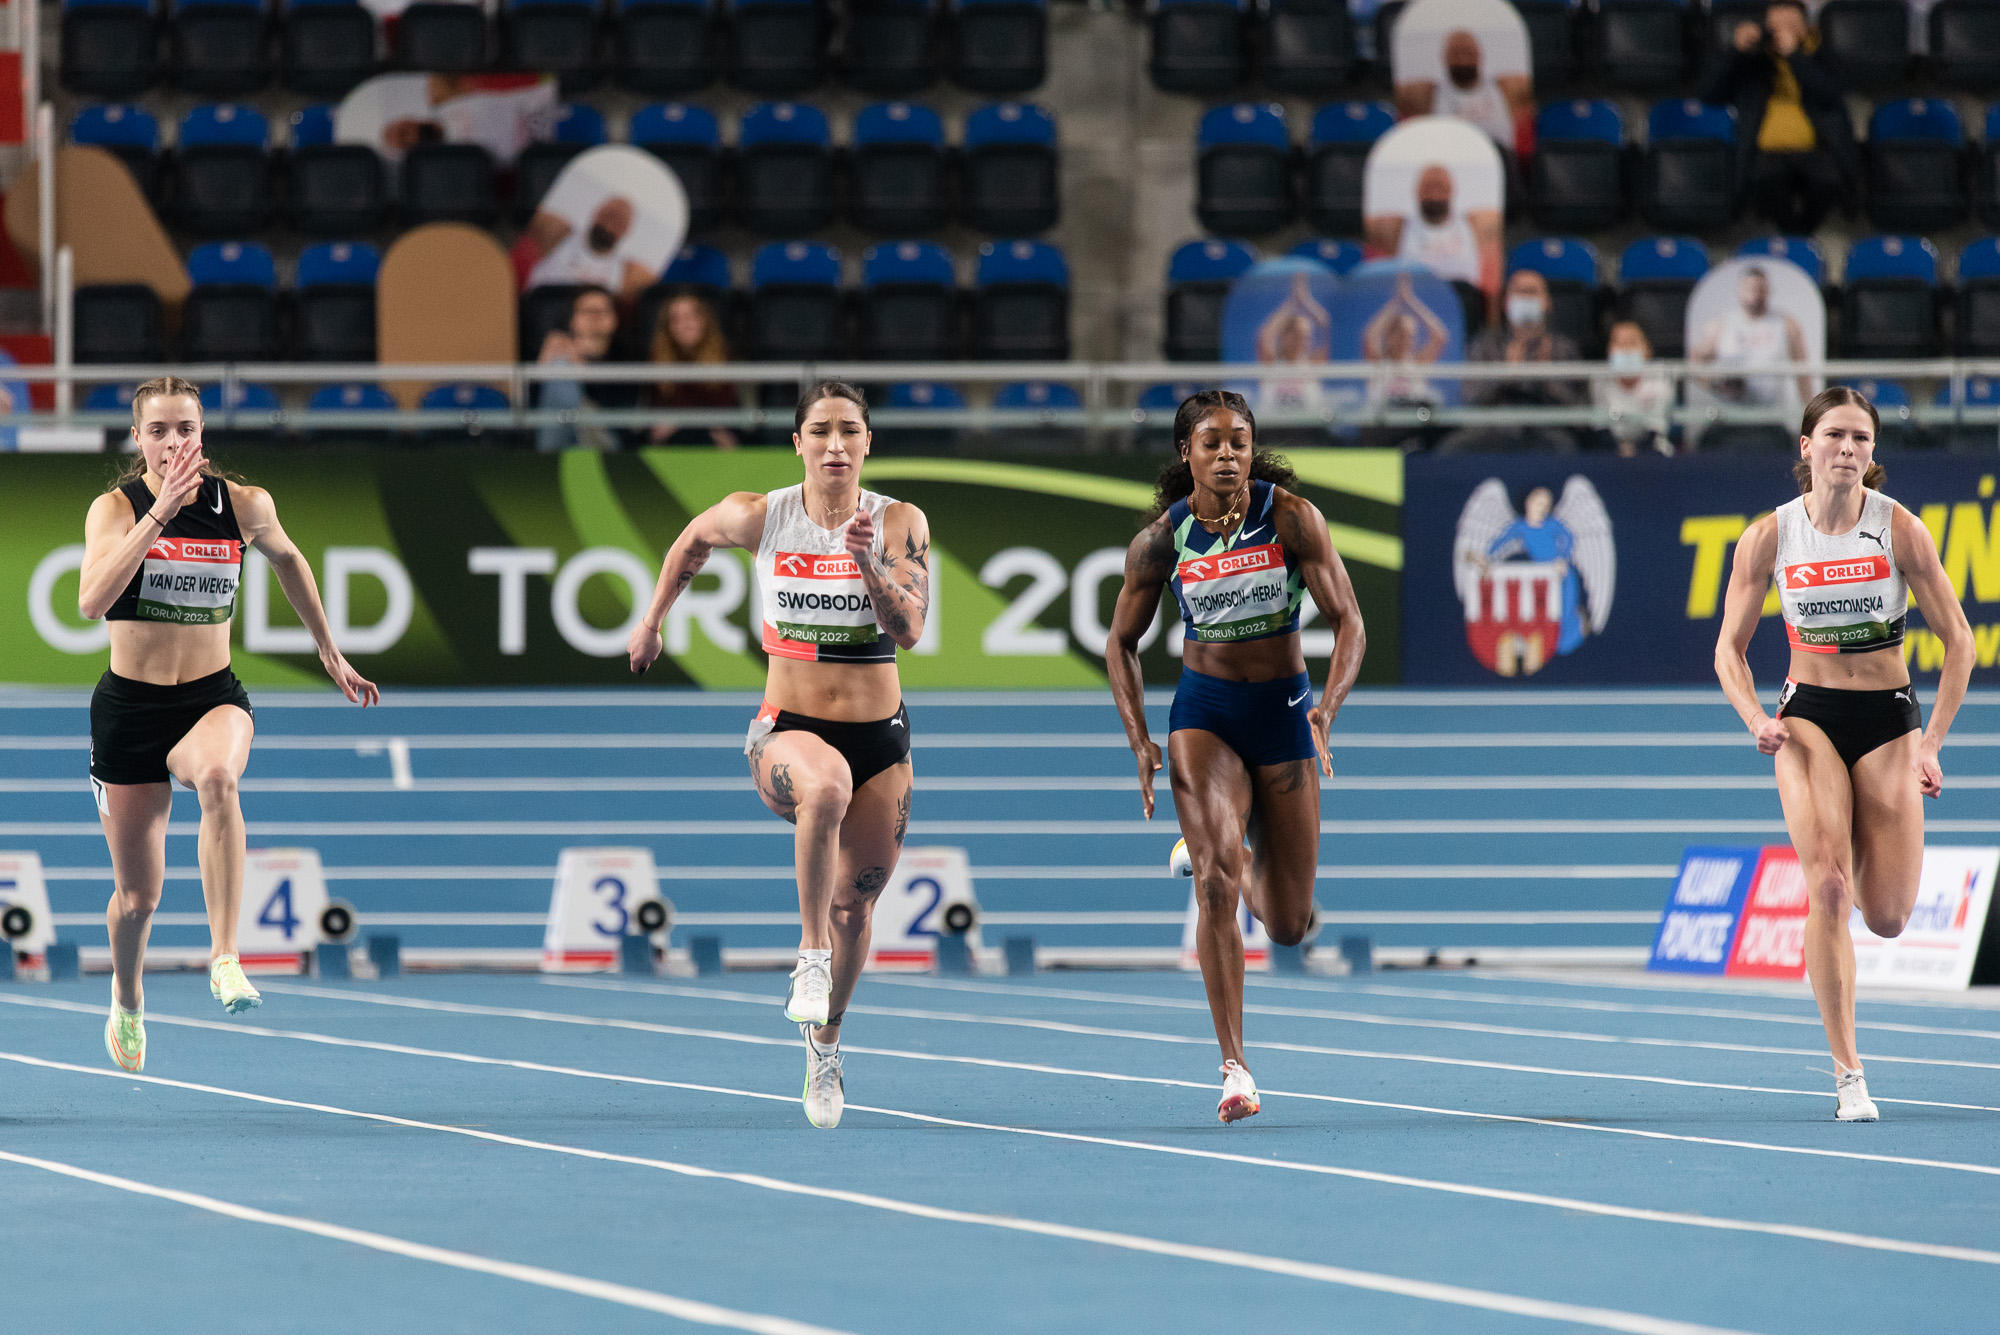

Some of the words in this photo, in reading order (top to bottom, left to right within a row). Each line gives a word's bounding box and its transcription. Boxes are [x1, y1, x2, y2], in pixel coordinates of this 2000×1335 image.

[184, 545, 228, 557] ORLEN
[816, 562, 858, 573] ORLEN
[1221, 553, 1266, 570] ORLEN
[1826, 564, 1872, 579] ORLEN
[149, 573, 173, 590] VAN
[174, 575, 197, 593] DER
[199, 576, 236, 594] WEKEN
[777, 591, 873, 612] SWOBODA
[1191, 588, 1250, 613] THOMPSON-
[1251, 581, 1283, 603] HERAH
[1797, 595, 1884, 617] SKRZYSZOWSKA
[144, 605, 182, 620] TORUŃ
[183, 612, 210, 622] 2022
[819, 632, 850, 642] 2022
[1201, 626, 1236, 639] TORUŃ
[1239, 621, 1268, 636] 2022
[1803, 631, 1839, 643] TORUŃ
[1841, 628, 1871, 641] 2022
[257, 877, 300, 941] 4
[592, 875, 629, 937] 3
[906, 876, 943, 937] 2
